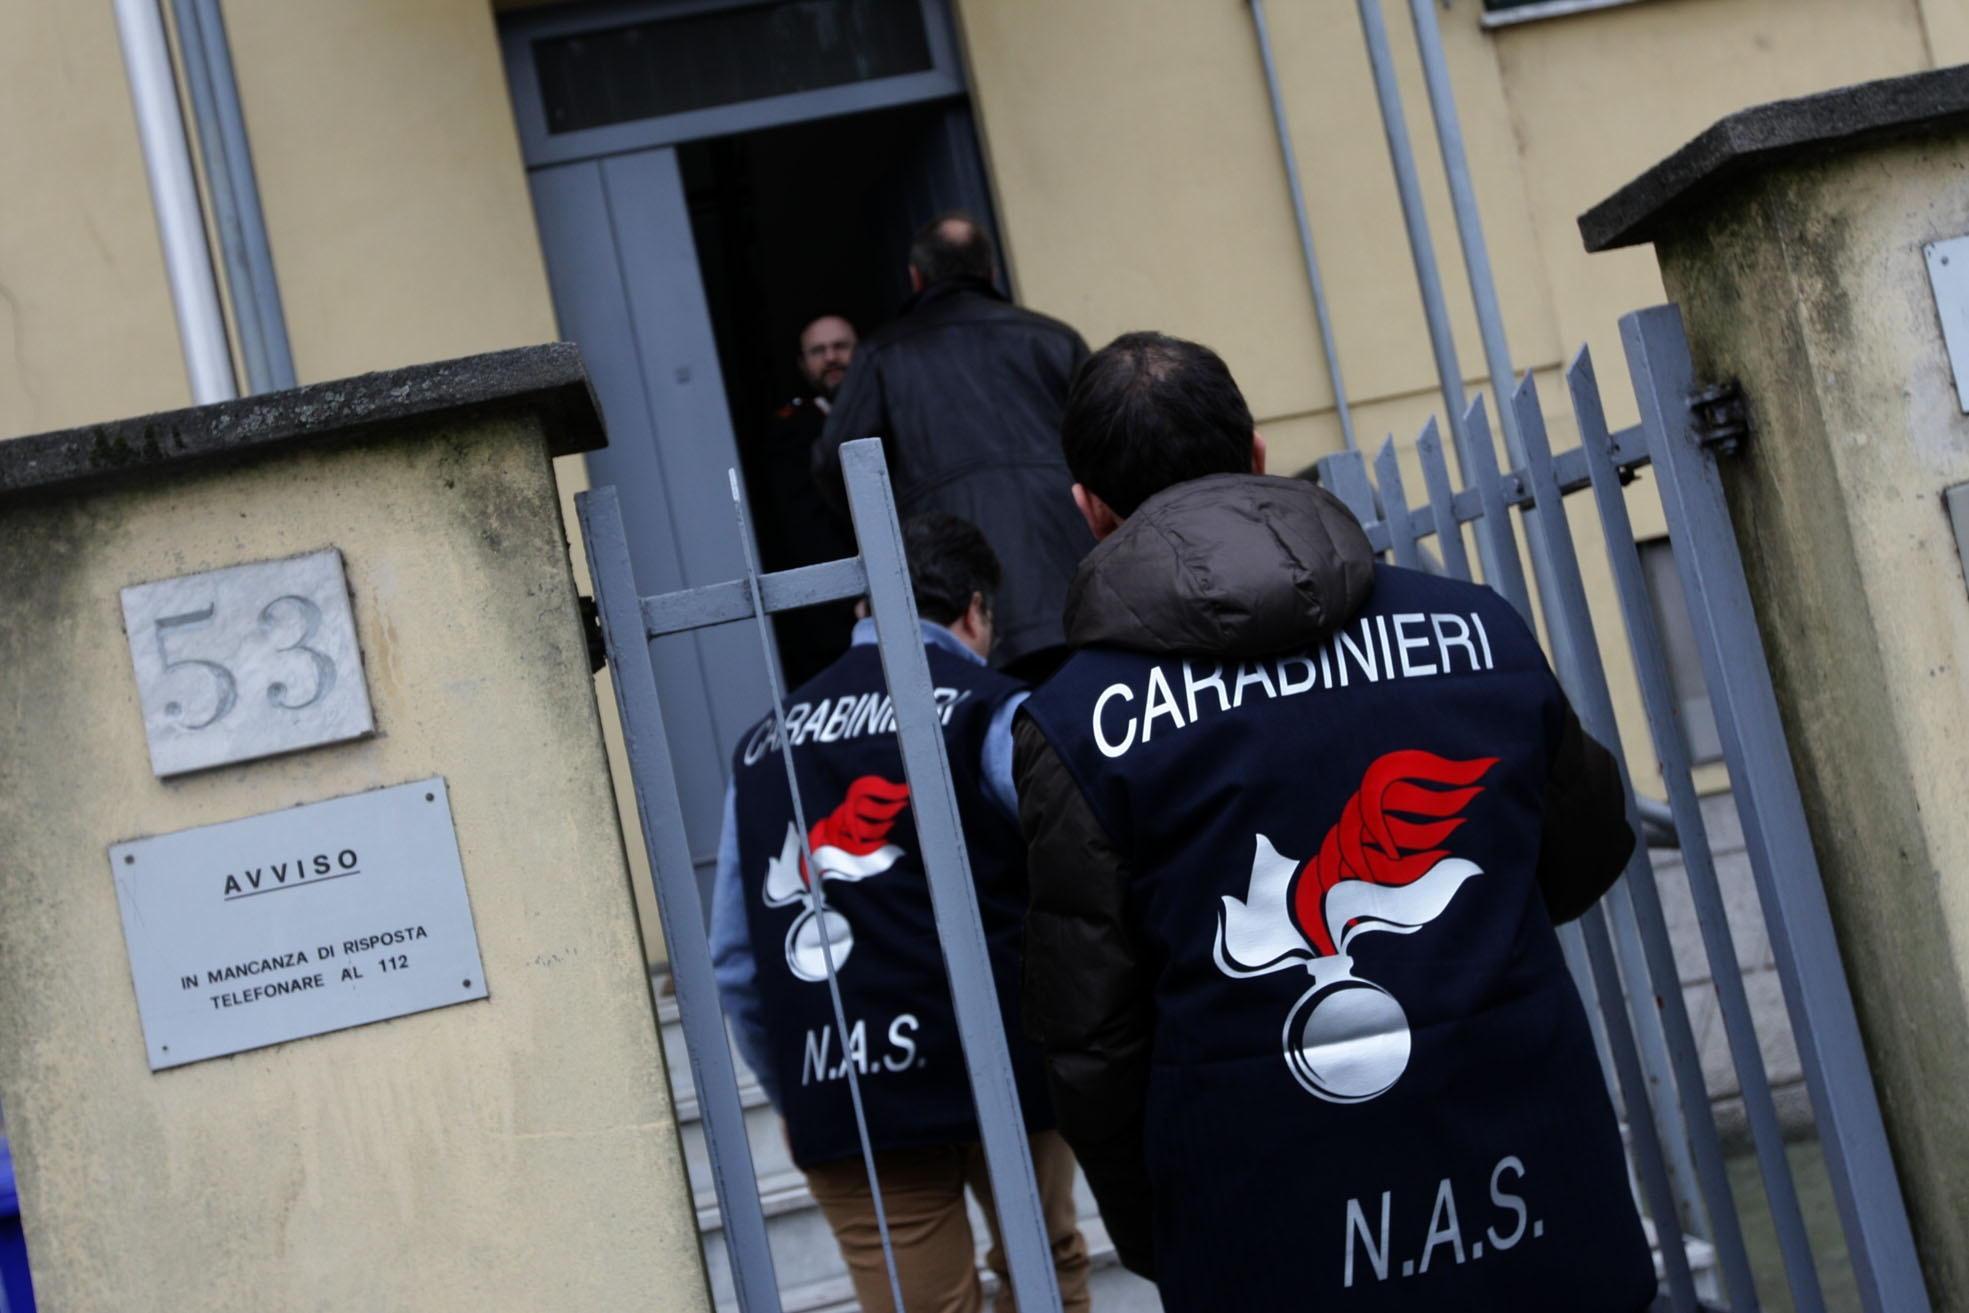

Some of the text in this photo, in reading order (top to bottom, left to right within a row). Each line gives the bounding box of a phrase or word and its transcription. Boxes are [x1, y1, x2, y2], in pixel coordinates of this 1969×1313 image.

[155, 594, 338, 730] 53
[1092, 612, 1494, 759] CARABINIERI
[223, 848, 359, 896] AVVISO
[180, 925, 428, 990] IN MANCANZA DI RISPOSTA
[210, 954, 410, 1010] TELEFONARE AL 112
[801, 1013, 926, 1087] N.A.S.
[1343, 1155, 1545, 1288] N.A.S.
